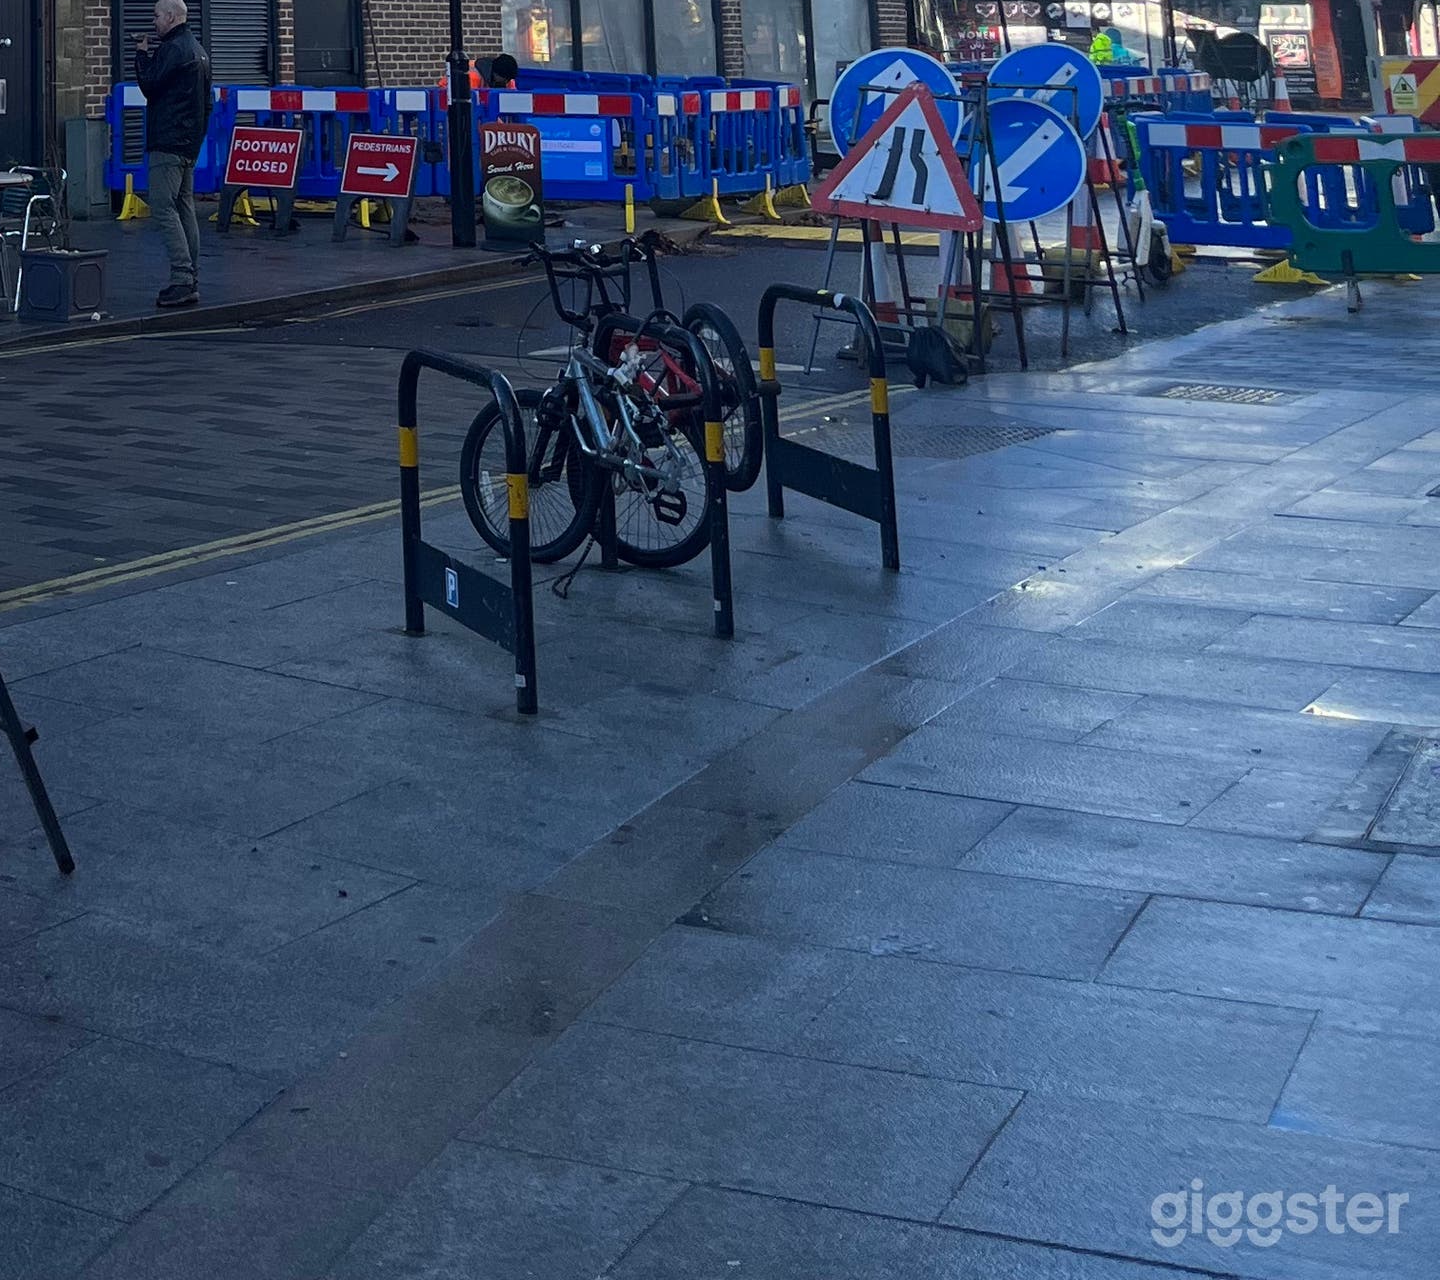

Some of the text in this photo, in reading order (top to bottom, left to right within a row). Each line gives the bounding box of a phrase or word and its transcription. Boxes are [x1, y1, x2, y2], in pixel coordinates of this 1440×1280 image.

[234, 139, 296, 154] FOOTWAY
[352, 141, 412, 153] PEDESTRIANS
[484, 130, 537, 157] DRURY
[235, 160, 288, 173] CLOSED
